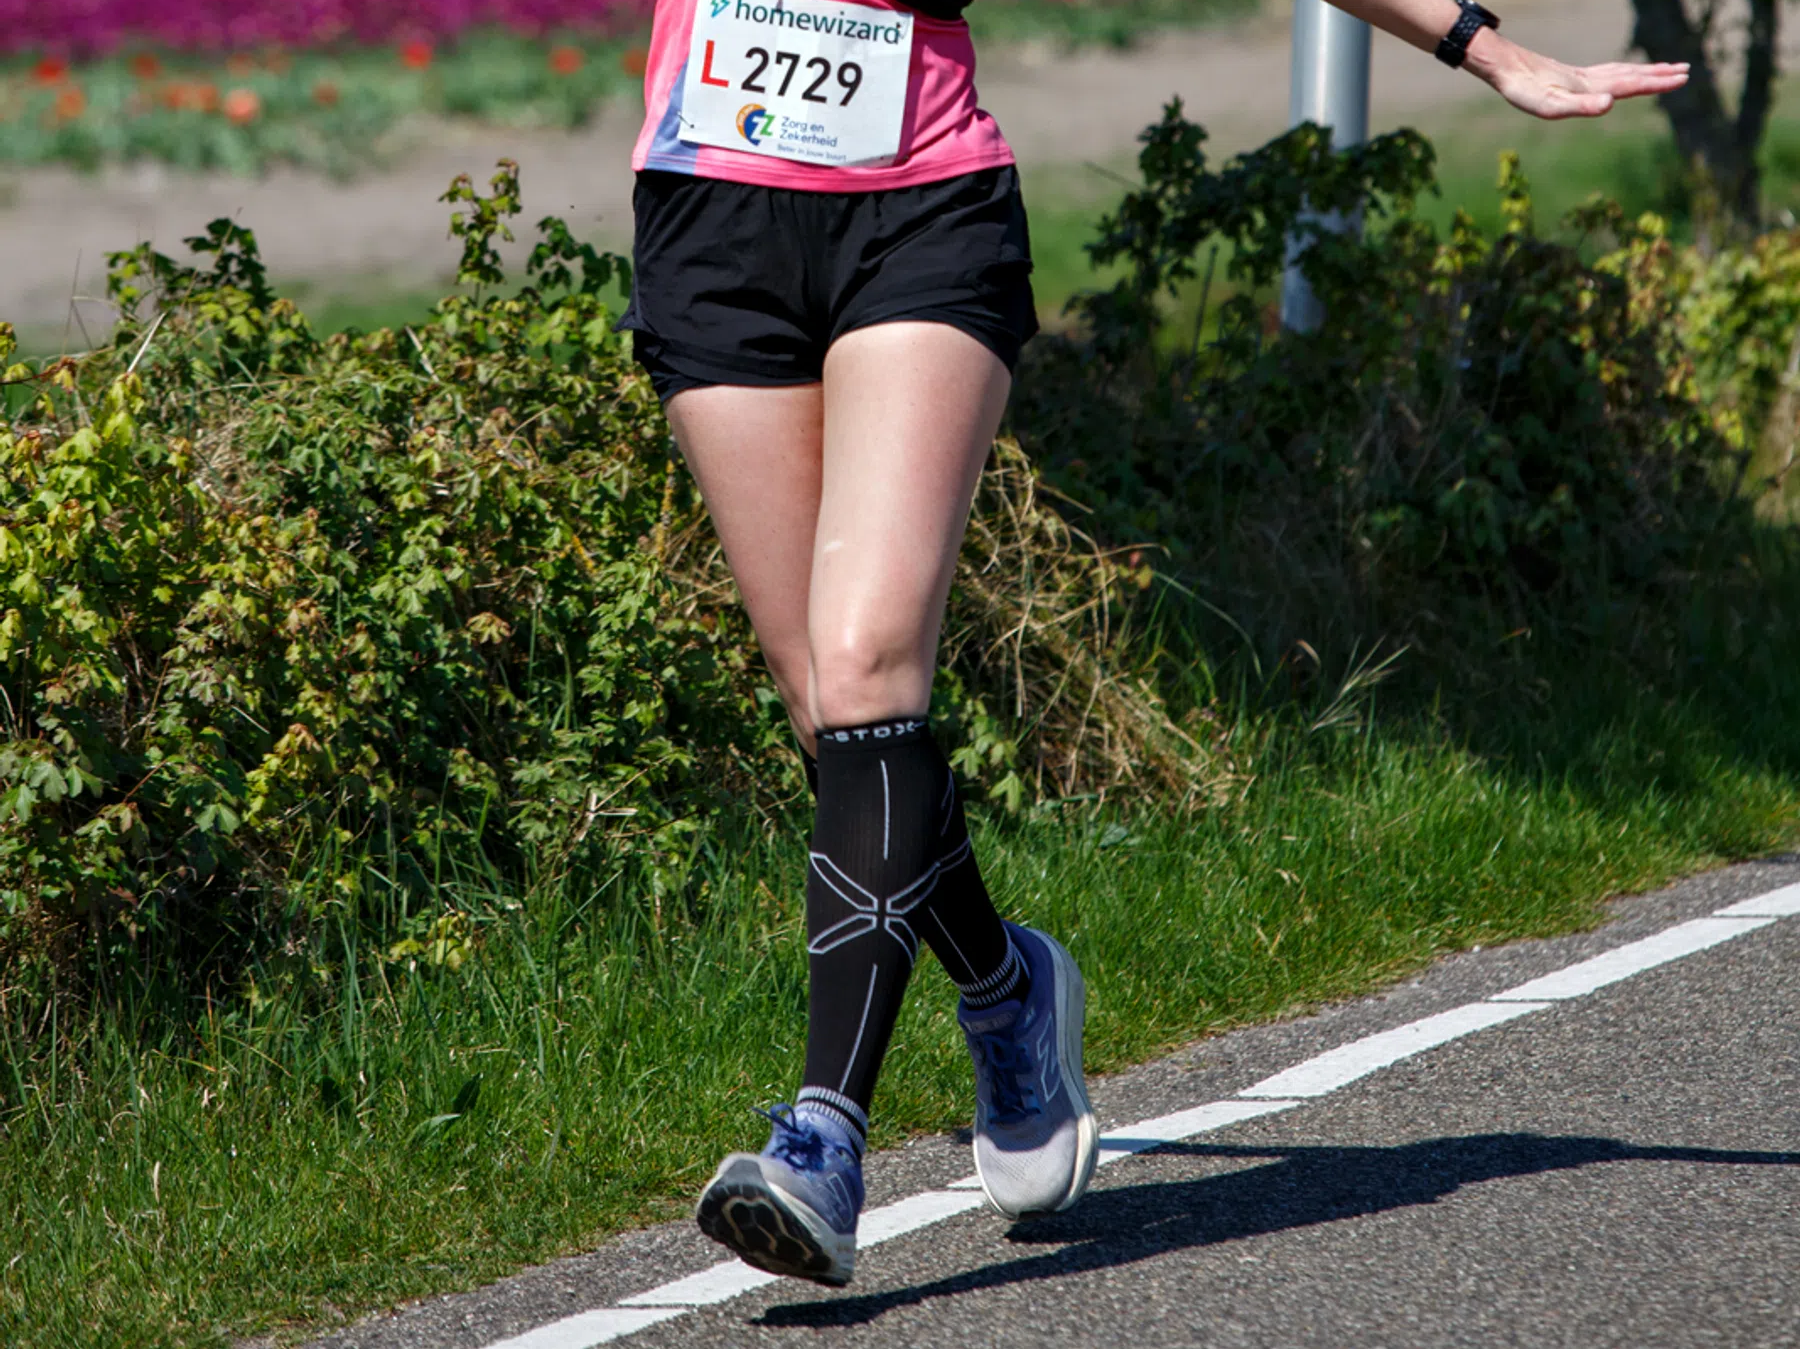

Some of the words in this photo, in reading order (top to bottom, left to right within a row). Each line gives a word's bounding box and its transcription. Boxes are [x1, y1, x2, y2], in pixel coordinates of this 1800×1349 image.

[700, 39, 730, 88] L
[741, 46, 863, 106] 2729
[781, 116, 807, 133] Zorg
[810, 123, 825, 133] en
[780, 129, 838, 148] Zekerheid
